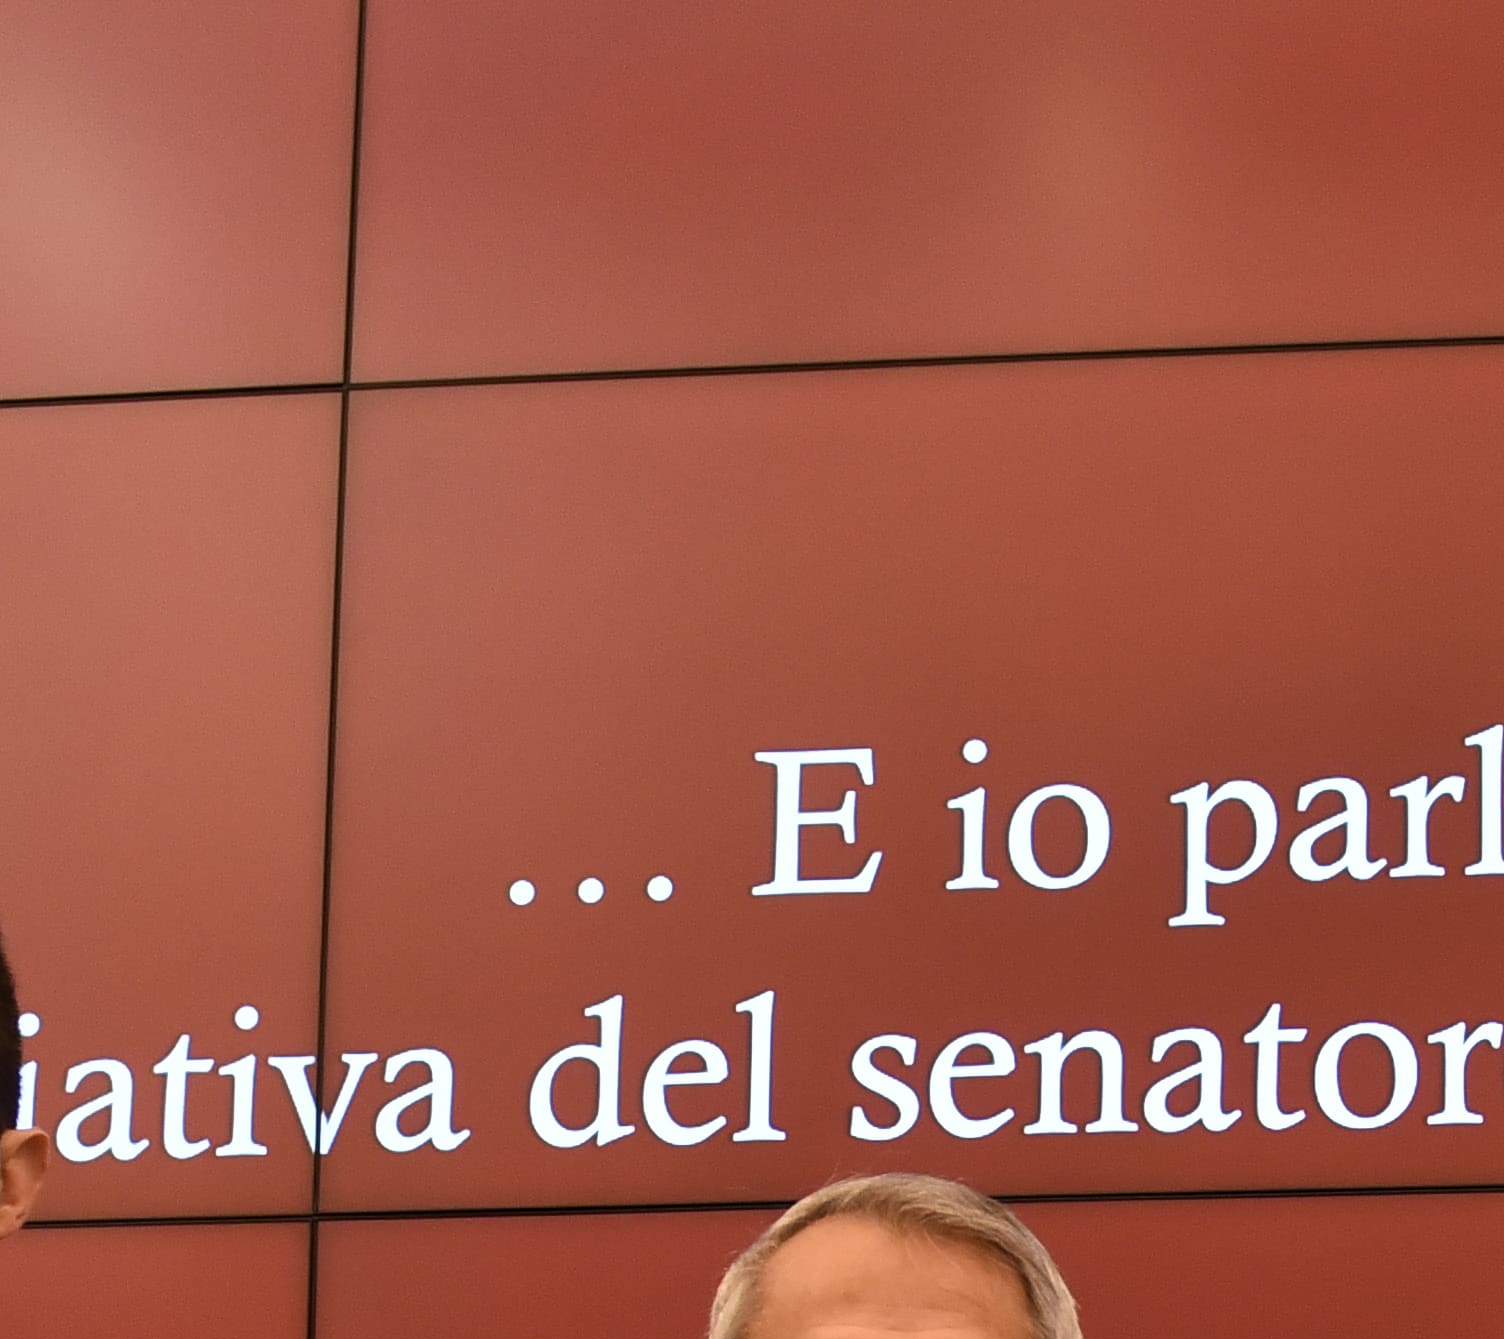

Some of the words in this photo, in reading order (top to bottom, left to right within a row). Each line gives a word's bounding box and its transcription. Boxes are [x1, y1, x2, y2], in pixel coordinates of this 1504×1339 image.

[750, 747, 883, 897] E
[945, 738, 1111, 891] io
[16, 1004, 471, 1163] iativa
[528, 989, 787, 1149] del
